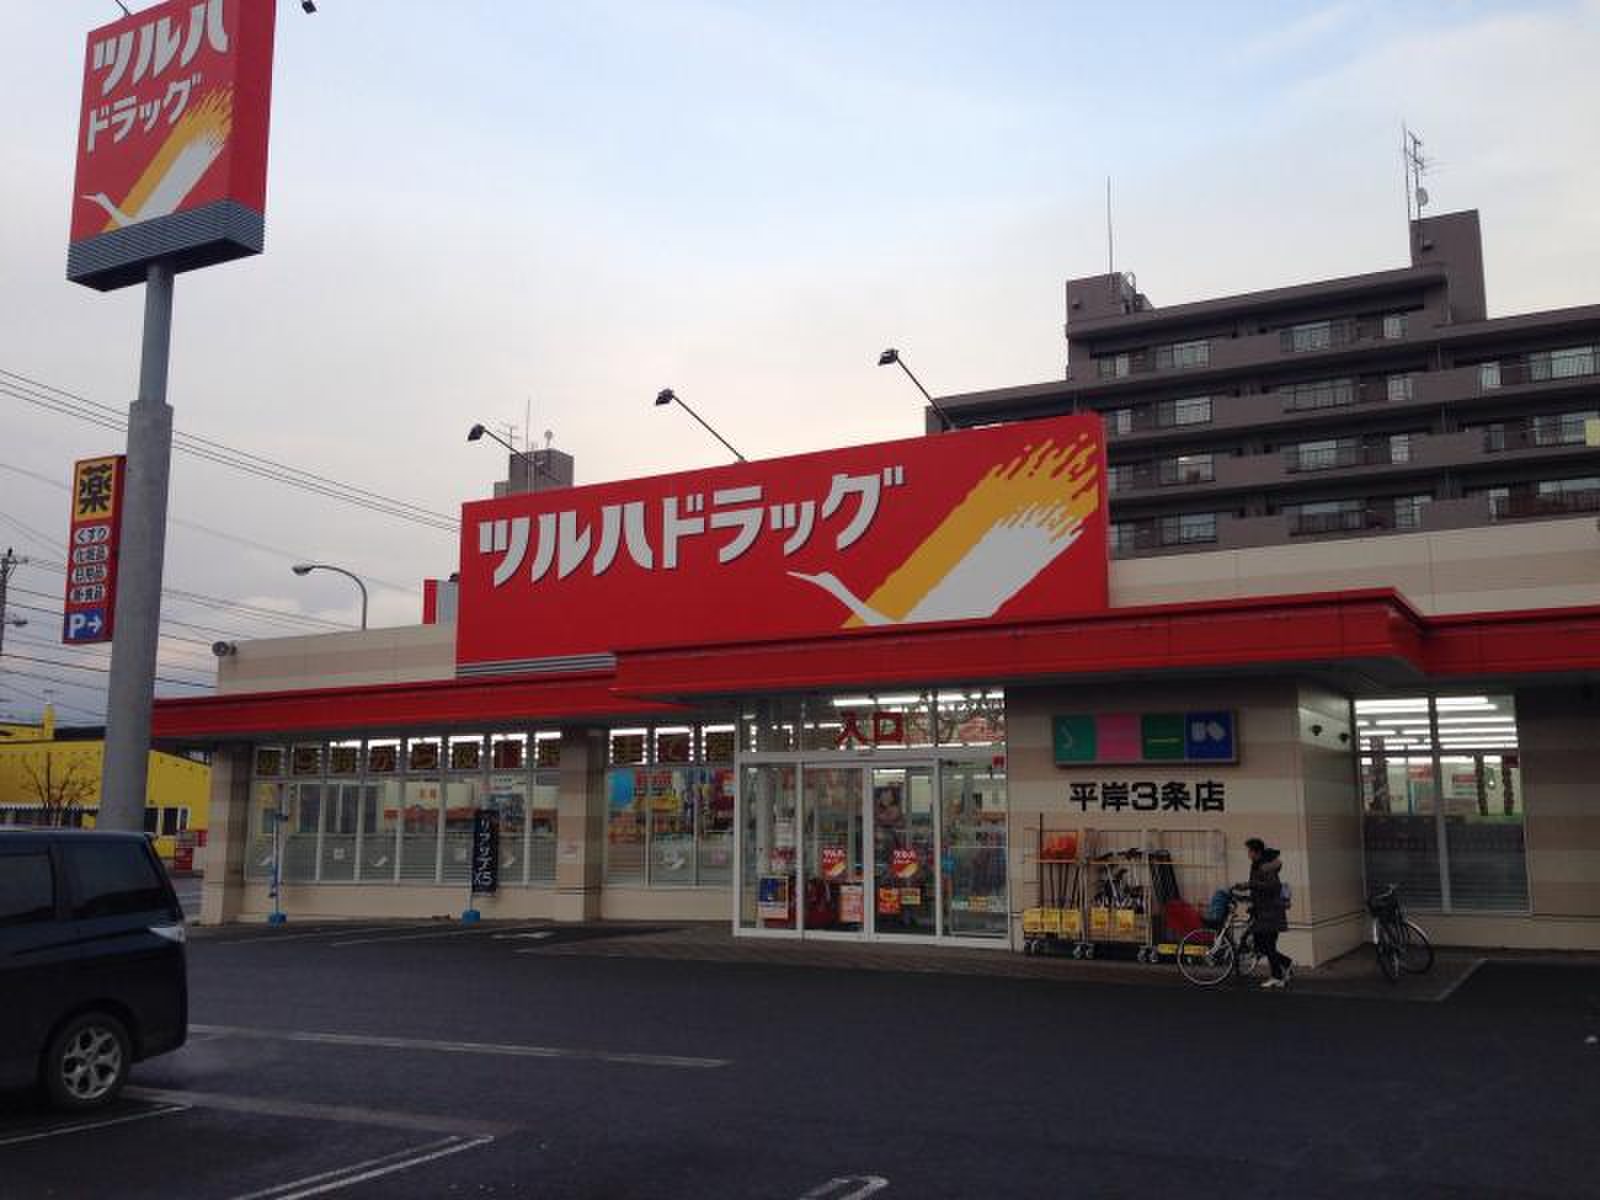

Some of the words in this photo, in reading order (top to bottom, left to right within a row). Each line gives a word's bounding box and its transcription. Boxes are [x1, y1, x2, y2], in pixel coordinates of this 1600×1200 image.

[93, 0, 230, 98] ツルハ
[86, 72, 202, 153] ドラッグ
[79, 464, 113, 515] 薬
[478, 465, 905, 588] ツルハドラッグ
[69, 613, 86, 640] P
[834, 710, 905, 747] 入口
[1069, 780, 1225, 813] 平岸3条店
